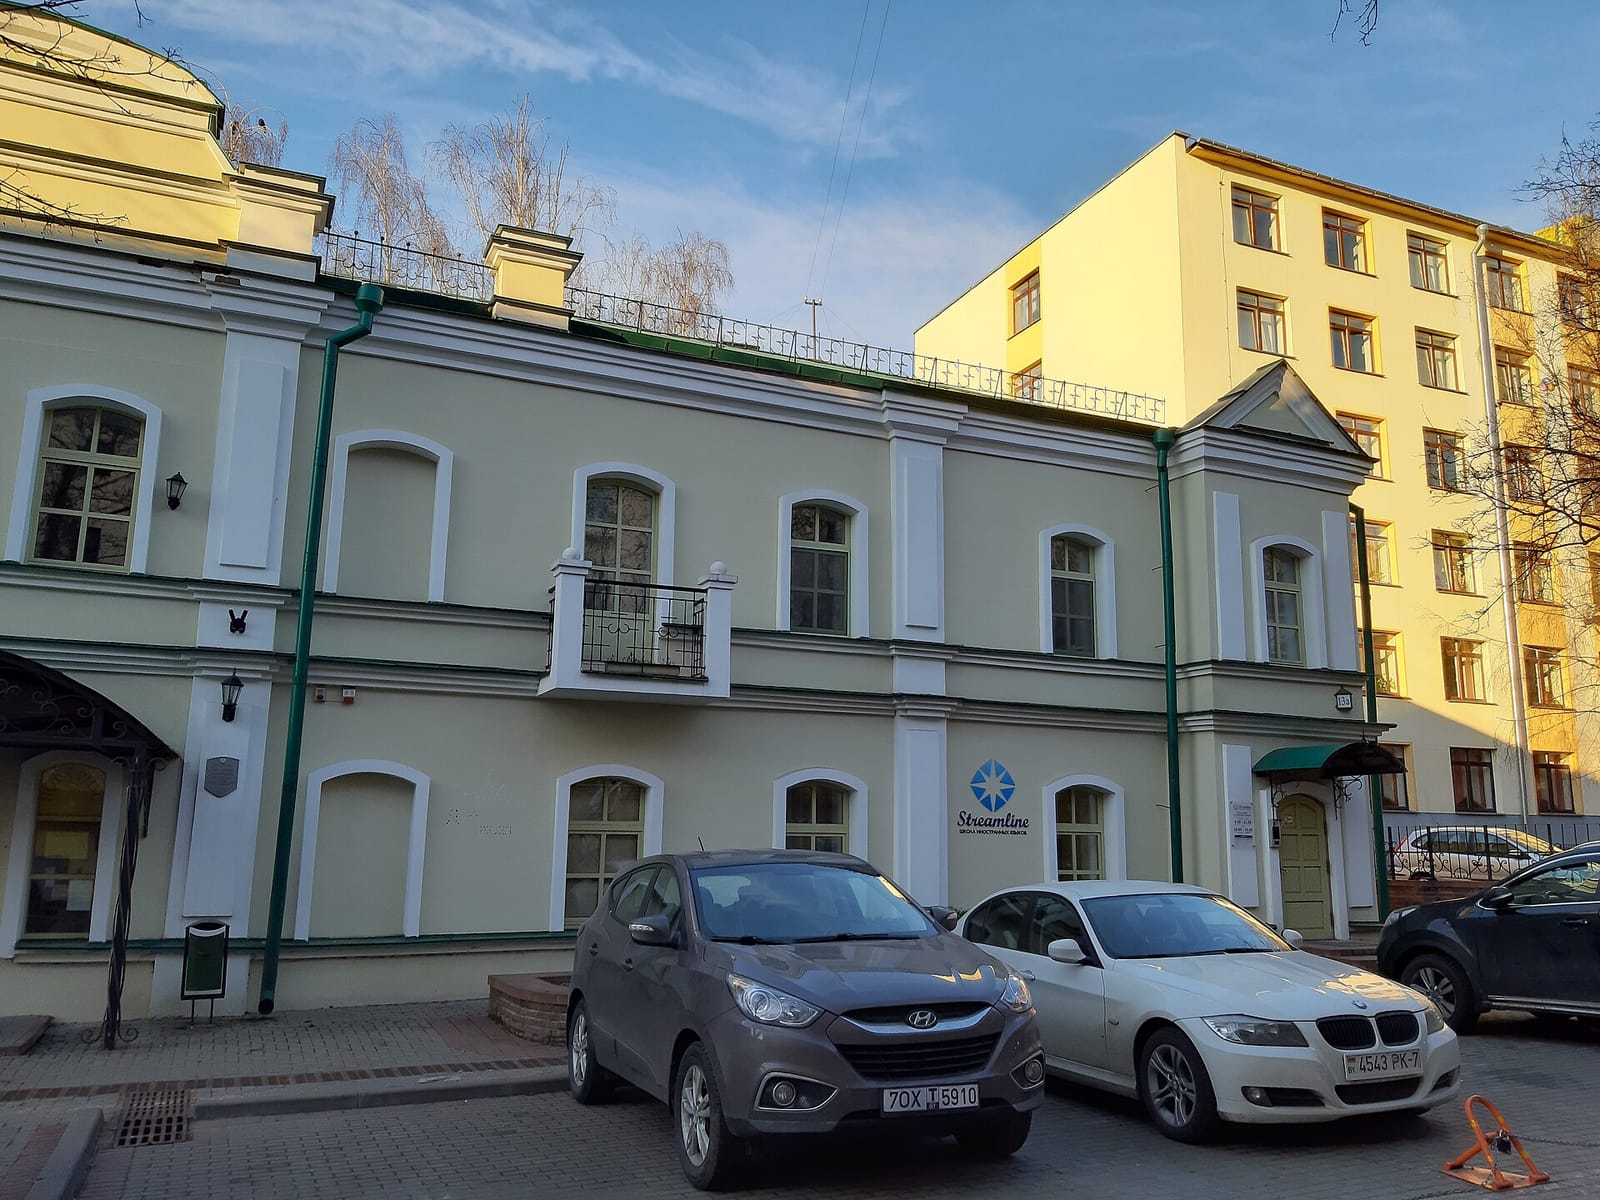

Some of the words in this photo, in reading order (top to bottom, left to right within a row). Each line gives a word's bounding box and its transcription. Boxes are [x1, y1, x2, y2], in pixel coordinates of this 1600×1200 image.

[957, 810, 1029, 828] Streamline
[1360, 1055, 1388, 1073] 4543
[1391, 1051, 1419, 1071] PK-7
